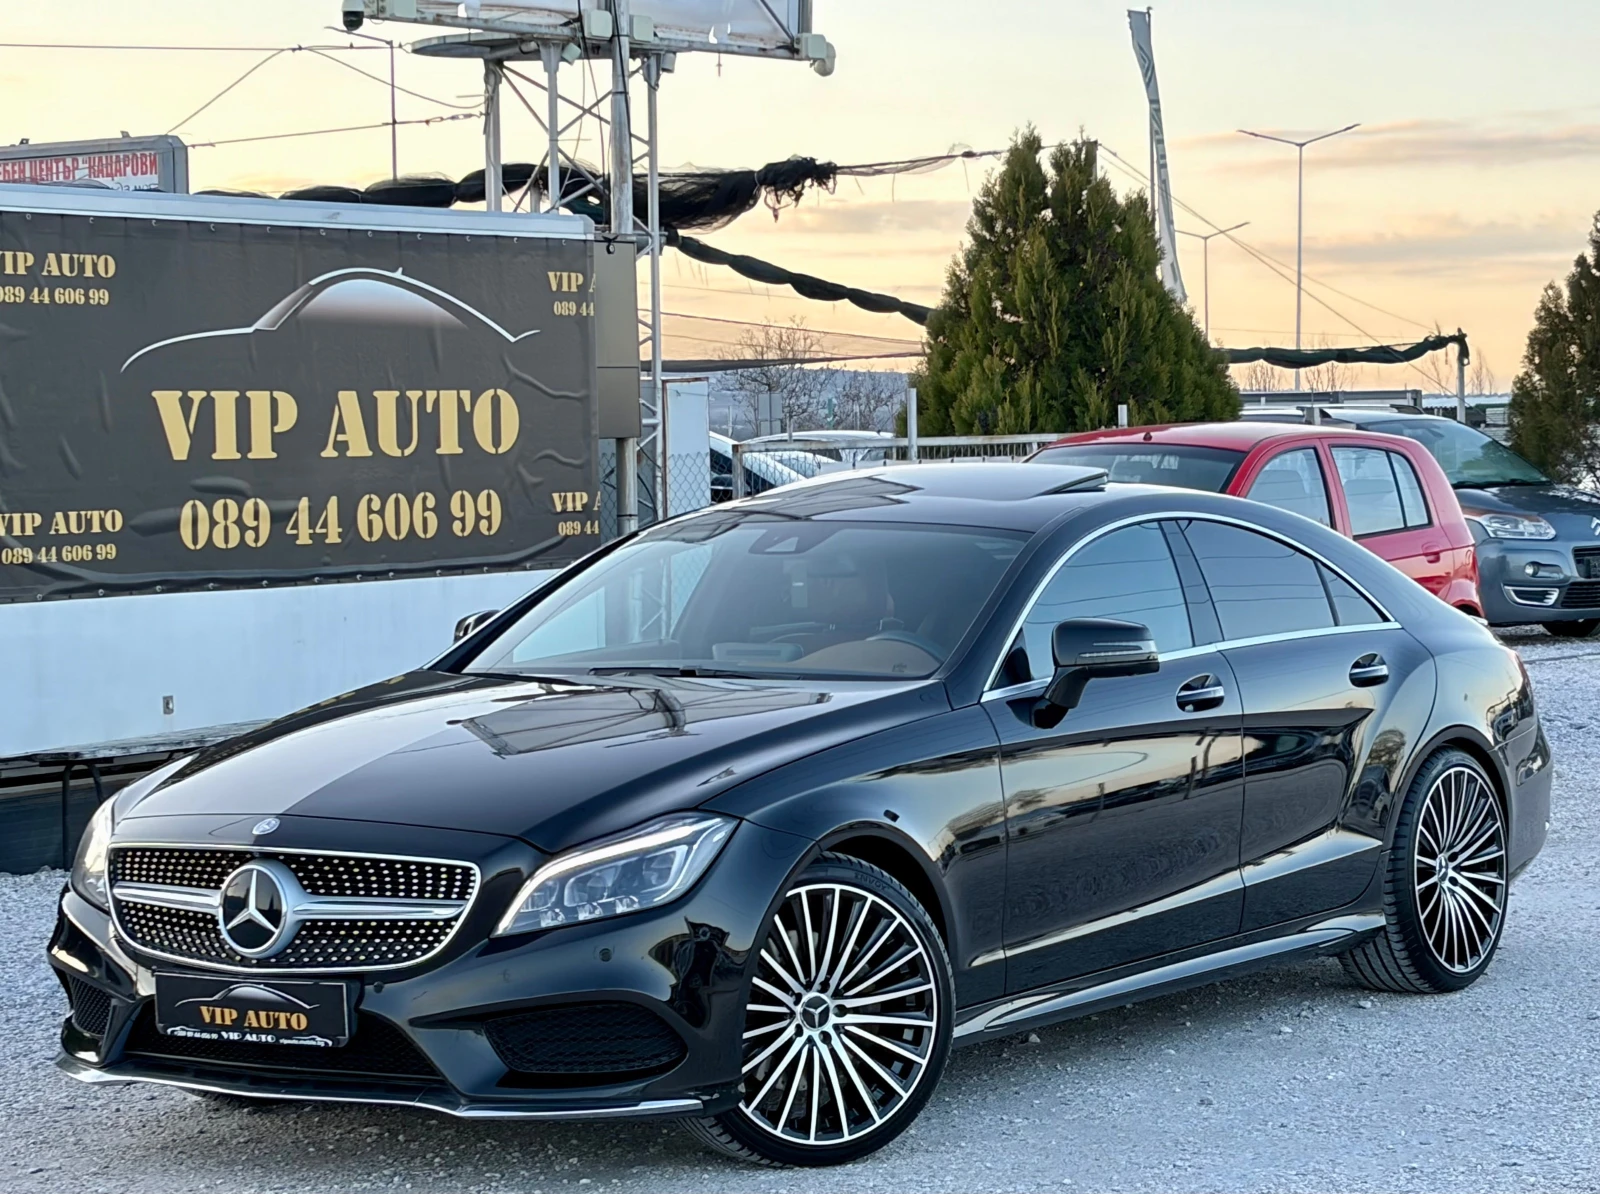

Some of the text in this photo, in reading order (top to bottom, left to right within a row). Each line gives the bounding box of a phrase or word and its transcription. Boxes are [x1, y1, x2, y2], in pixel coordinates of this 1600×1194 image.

[0, 161, 26, 183] БЕН
[30, 156, 79, 184] ЦЕНТЪР
[0, 250, 116, 278] IP AUTO
[547, 271, 584, 292] VIP
[29, 287, 51, 304] 44
[54, 287, 85, 305] 606
[88, 288, 110, 306] 99
[553, 301, 595, 316] 089 44
[151, 388, 520, 461] VIP AUTO
[552, 491, 589, 513] VIP
[48, 509, 123, 535] AUTO
[179, 489, 502, 550] 089 44 606 99
[558, 520, 600, 536] 089 44
[1, 543, 117, 565] 089 44 606 99
[200, 1006, 308, 1030] VIP AUTO
[220, 1031, 242, 1041] VIP
[243, 1033, 276, 1043] AUTO
